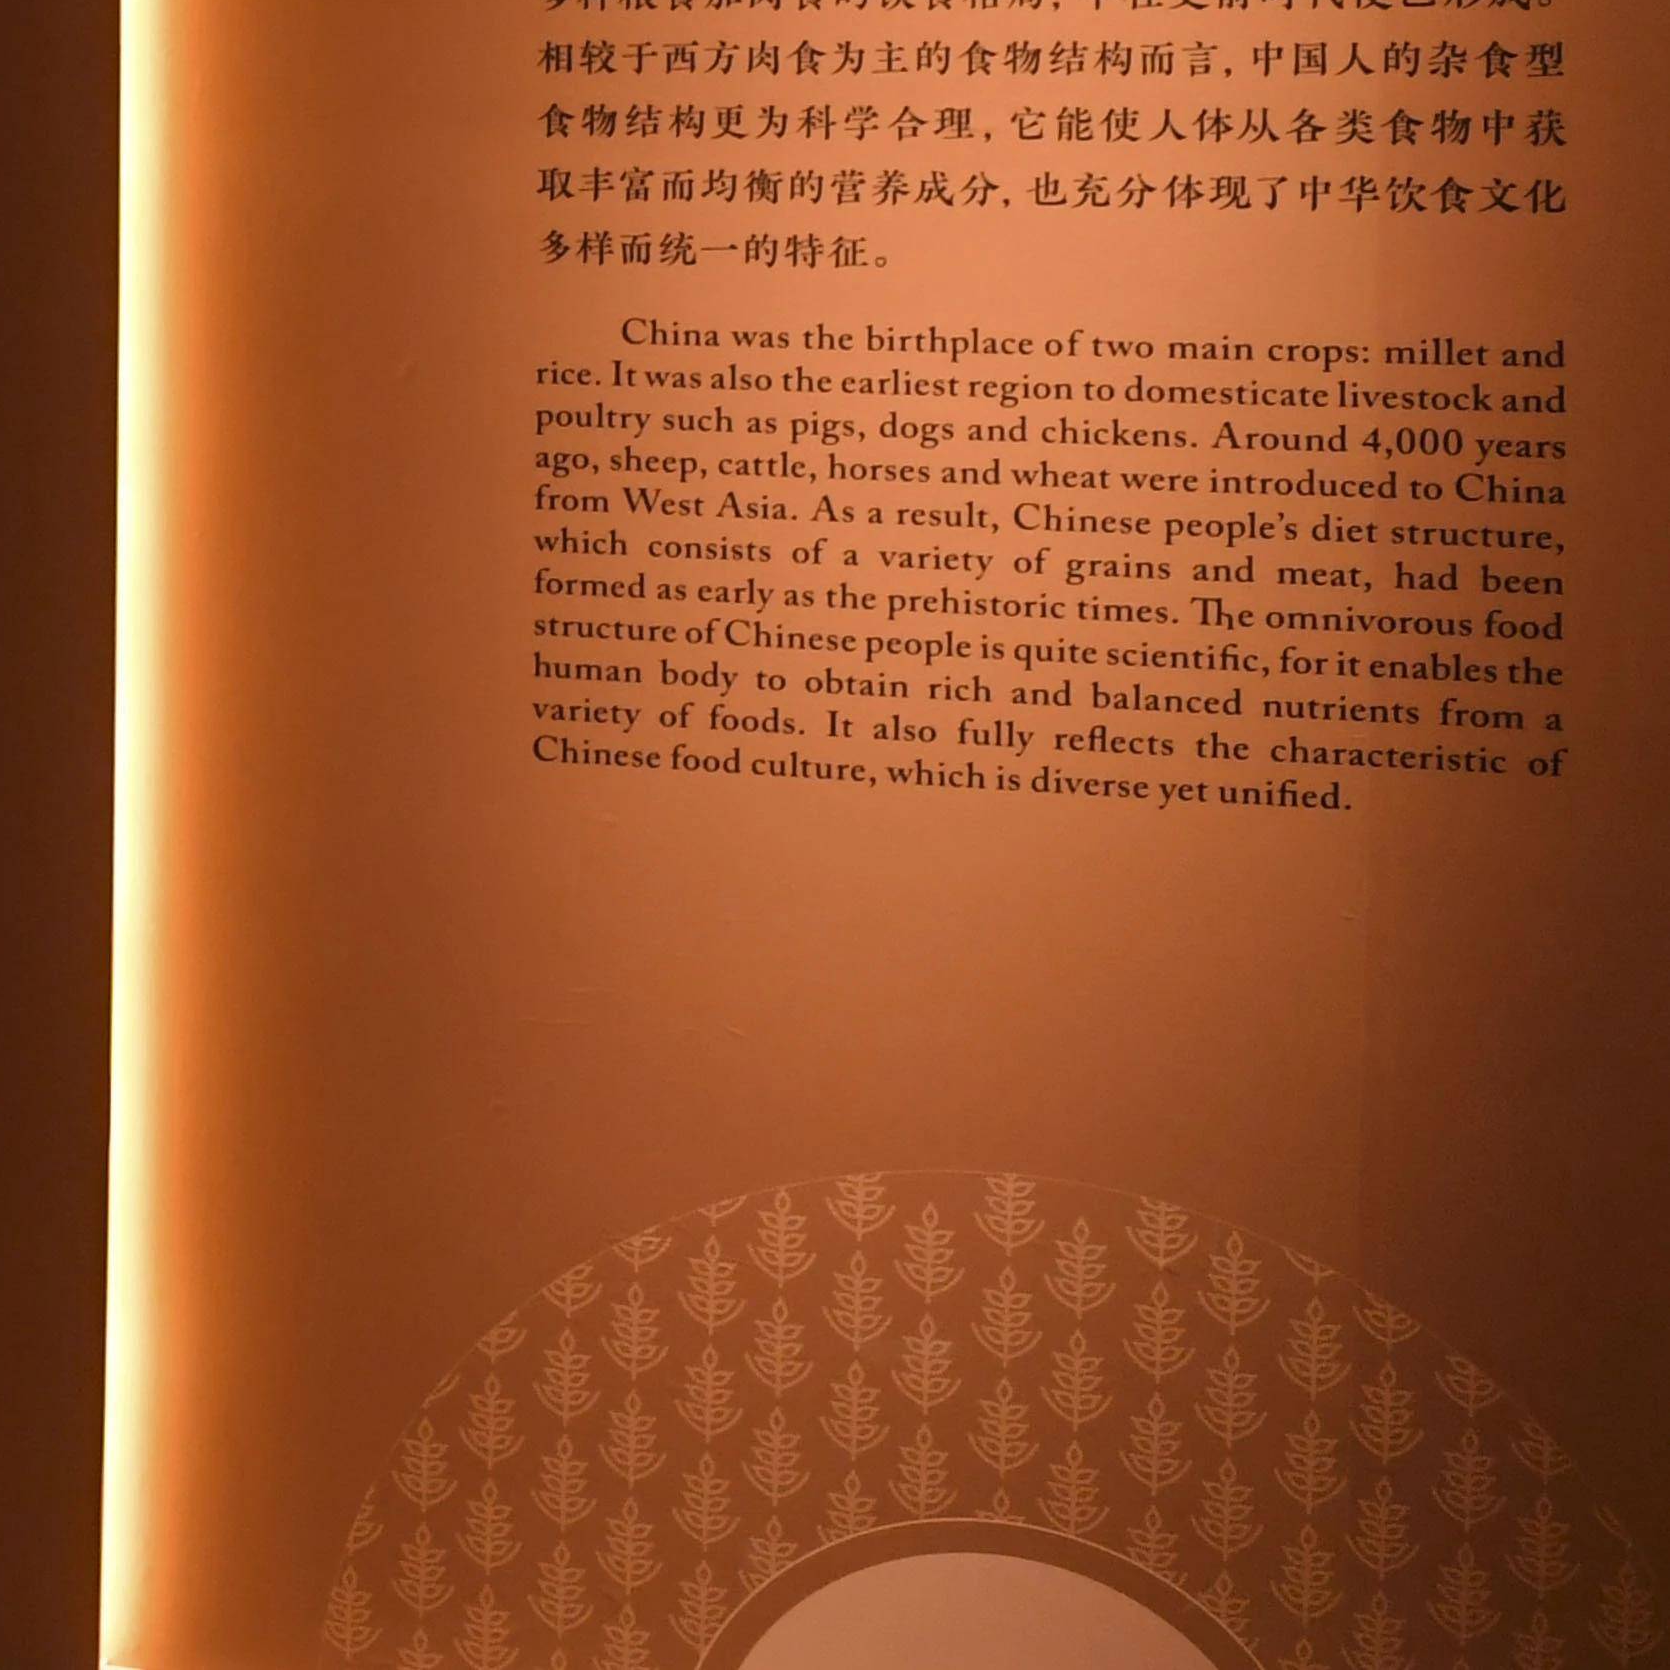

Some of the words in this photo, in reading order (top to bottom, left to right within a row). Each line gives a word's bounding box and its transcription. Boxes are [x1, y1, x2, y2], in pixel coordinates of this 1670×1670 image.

[538, 39, 1564, 79] 相较于西方肉食为主的食物结构而言，中国人的杂食型
[538, 103, 1566, 147] 食物结构更为科学合理，它能使人体从各类食物中获
[537, 165, 1565, 214] 取丰富而均衡的营养成分，也充分体现了中华饮食文化
[540, 229, 887, 270] 多样而统一的特征。
[622, 318, 720, 347] China
[732, 331, 789, 349] was
[803, 323, 853, 351] the
[866, 324, 1034, 364] birthplace
[1045, 328, 1084, 357] of
[1092, 337, 1154, 359] two
[1168, 335, 1253, 361] main
[1268, 344, 1369, 373] crops:
[1385, 337, 1488, 366] millet
[1502, 340, 1564, 368] and
[537, 361, 601, 386] rice.
[612, 359, 637, 388] It
[644, 371, 701, 389] was
[711, 363, 772, 392] also
[782, 365, 832, 394] the
[841, 368, 959, 398] earliest
[969, 374, 1073, 409] region
[1083, 380, 1115, 402] to
[1124, 374, 1328, 408] domesticate
[1338, 380, 1492, 412] livestock
[1502, 385, 1566, 413] and
[536, 401, 651, 439] poultry
[663, 406, 733, 433] such
[747, 416, 777, 435] as
[790, 410, 865, 447] pigs,
[879, 410, 954, 449] dogs
[968, 415, 1028, 443] and
[1041, 415, 1197, 449] chickens.
[1211, 420, 1348, 453] Around
[1362, 426, 1463, 460] 4,000
[1475, 439, 1565, 466] years
[536, 451, 599, 479] ago,
[610, 445, 707, 483] sheep,
[718, 450, 816, 485] cattle,
[828, 452, 930, 483] horses
[941, 458, 1001, 486] and
[1011, 460, 1111, 490] wheat
[1120, 472, 1198, 493] were
[1209, 467, 1397, 499] introduced
[1410, 479, 1443, 501] to
[1455, 473, 1565, 505] China
[535, 483, 609, 513] from
[623, 486, 704, 517] West
[716, 490, 797, 521] Asia.
[810, 494, 854, 524] As
[868, 506, 883, 525] a
[897, 500, 999, 535] result,
[1014, 502, 1151, 535] Chinese
[1164, 511, 1297, 548] people's
[1312, 513, 1378, 544] diet
[1391, 524, 1564, 555] structure,
